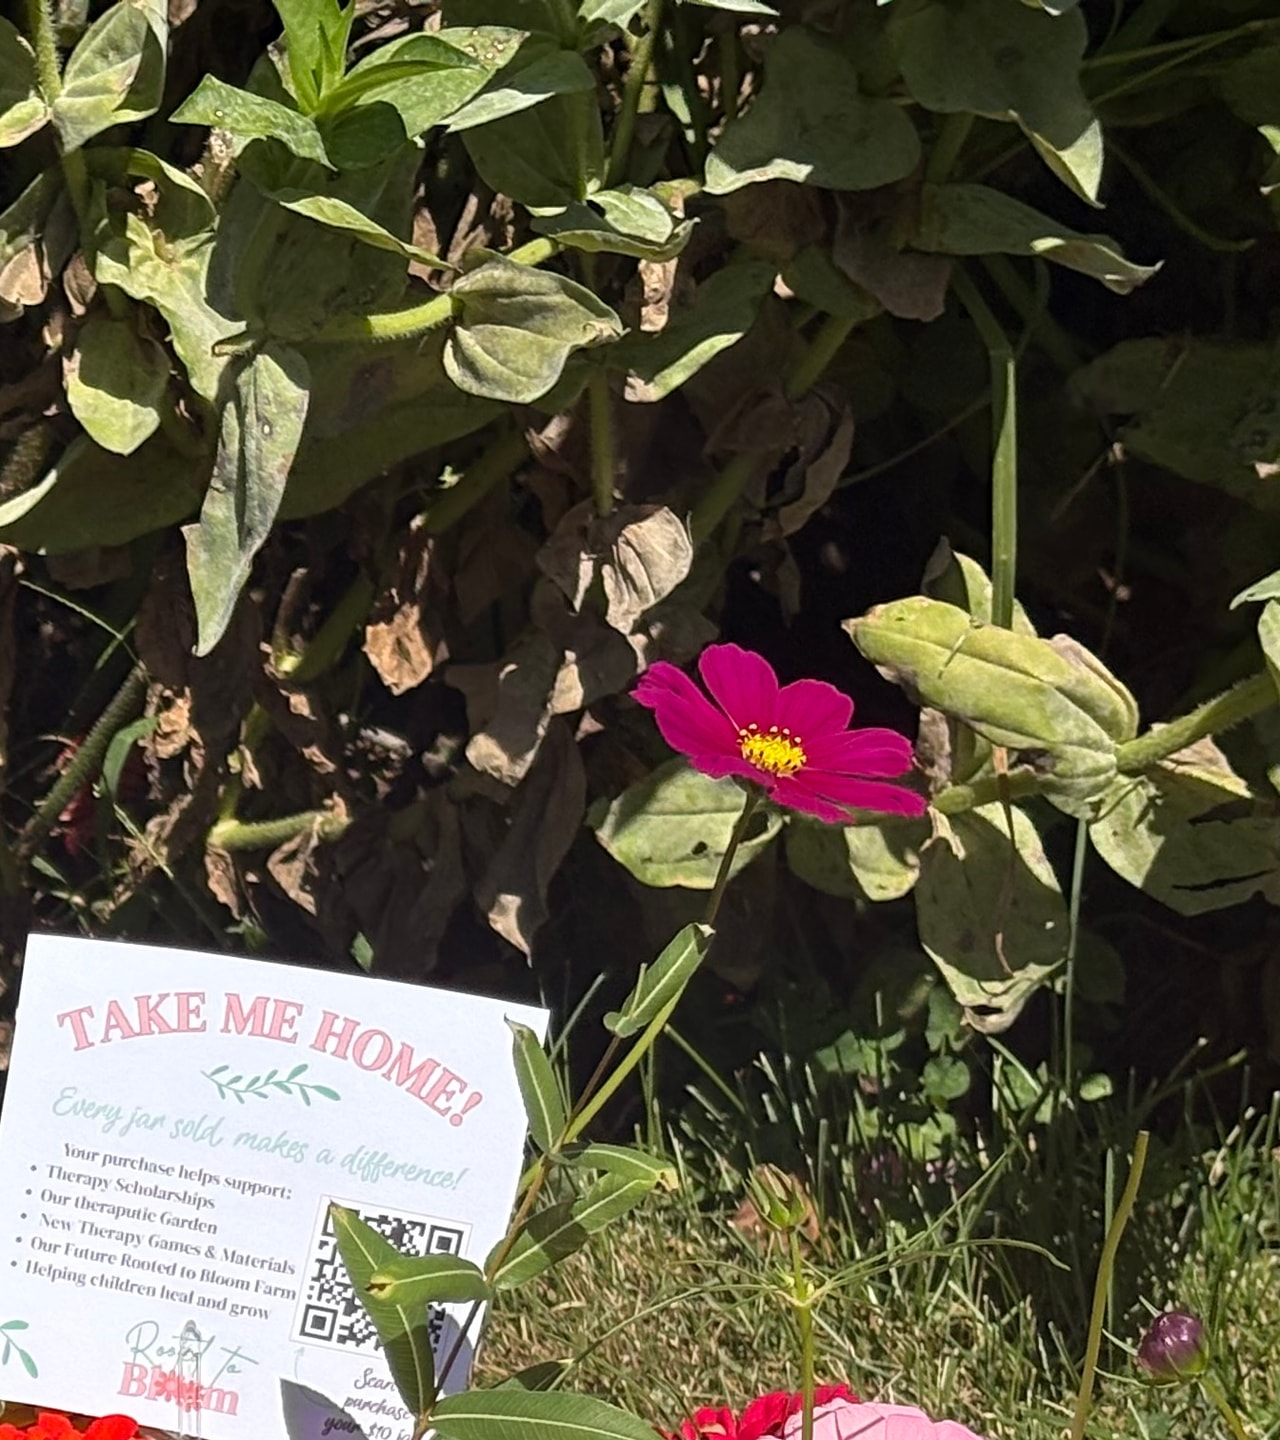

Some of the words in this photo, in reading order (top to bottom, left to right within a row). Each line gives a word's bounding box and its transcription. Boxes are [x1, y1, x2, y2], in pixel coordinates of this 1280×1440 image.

[57, 992, 207, 1052] TAKE
[220, 993, 303, 1045] ME
[309, 1009, 482, 1128] HOME!
[52, 1086, 122, 1134] Every
[120, 1106, 165, 1137] jar
[169, 1113, 225, 1147] sold
[234, 1128, 309, 1164] makes
[316, 1147, 337, 1165] a
[341, 1144, 470, 1190] difference!
[46, 1164, 113, 1193] Therapy
[115, 1178, 215, 1210] Scholarships
[64, 1142, 100, 1161] Your
[101, 1152, 175, 1177] purchase
[178, 1164, 221, 1187] helps
[224, 1175, 292, 1200] support:
[40, 1188, 71, 1206] Our
[74, 1196, 157, 1223] theraputic
[160, 1210, 218, 1235] Garden
[30, 1236, 62, 1254] Our
[64, 1242, 118, 1265] Future
[120, 1252, 177, 1277] Rooted
[180, 1265, 197, 1281] to
[199, 1268, 251, 1292] Bloom
[254, 1278, 297, 1301] Farm
[40, 1213, 74, 1232] New
[79, 1220, 145, 1248] Therapy
[148, 1233, 201, 1257] Games
[204, 1245, 217, 1260] &
[221, 1248, 296, 1276] Materials
[25, 1260, 87, 1288] Helping
[90, 1273, 157, 1297] children
[160, 1285, 194, 1304] heal
[196, 1296, 228, 1312] and
[228, 1302, 272, 1321] grow
[344, 1396, 411, 1421] purchase
[354, 1368, 396, 1392] Scan
[321, 1417, 361, 1436] your
[368, 1422, 392, 1440] $10
